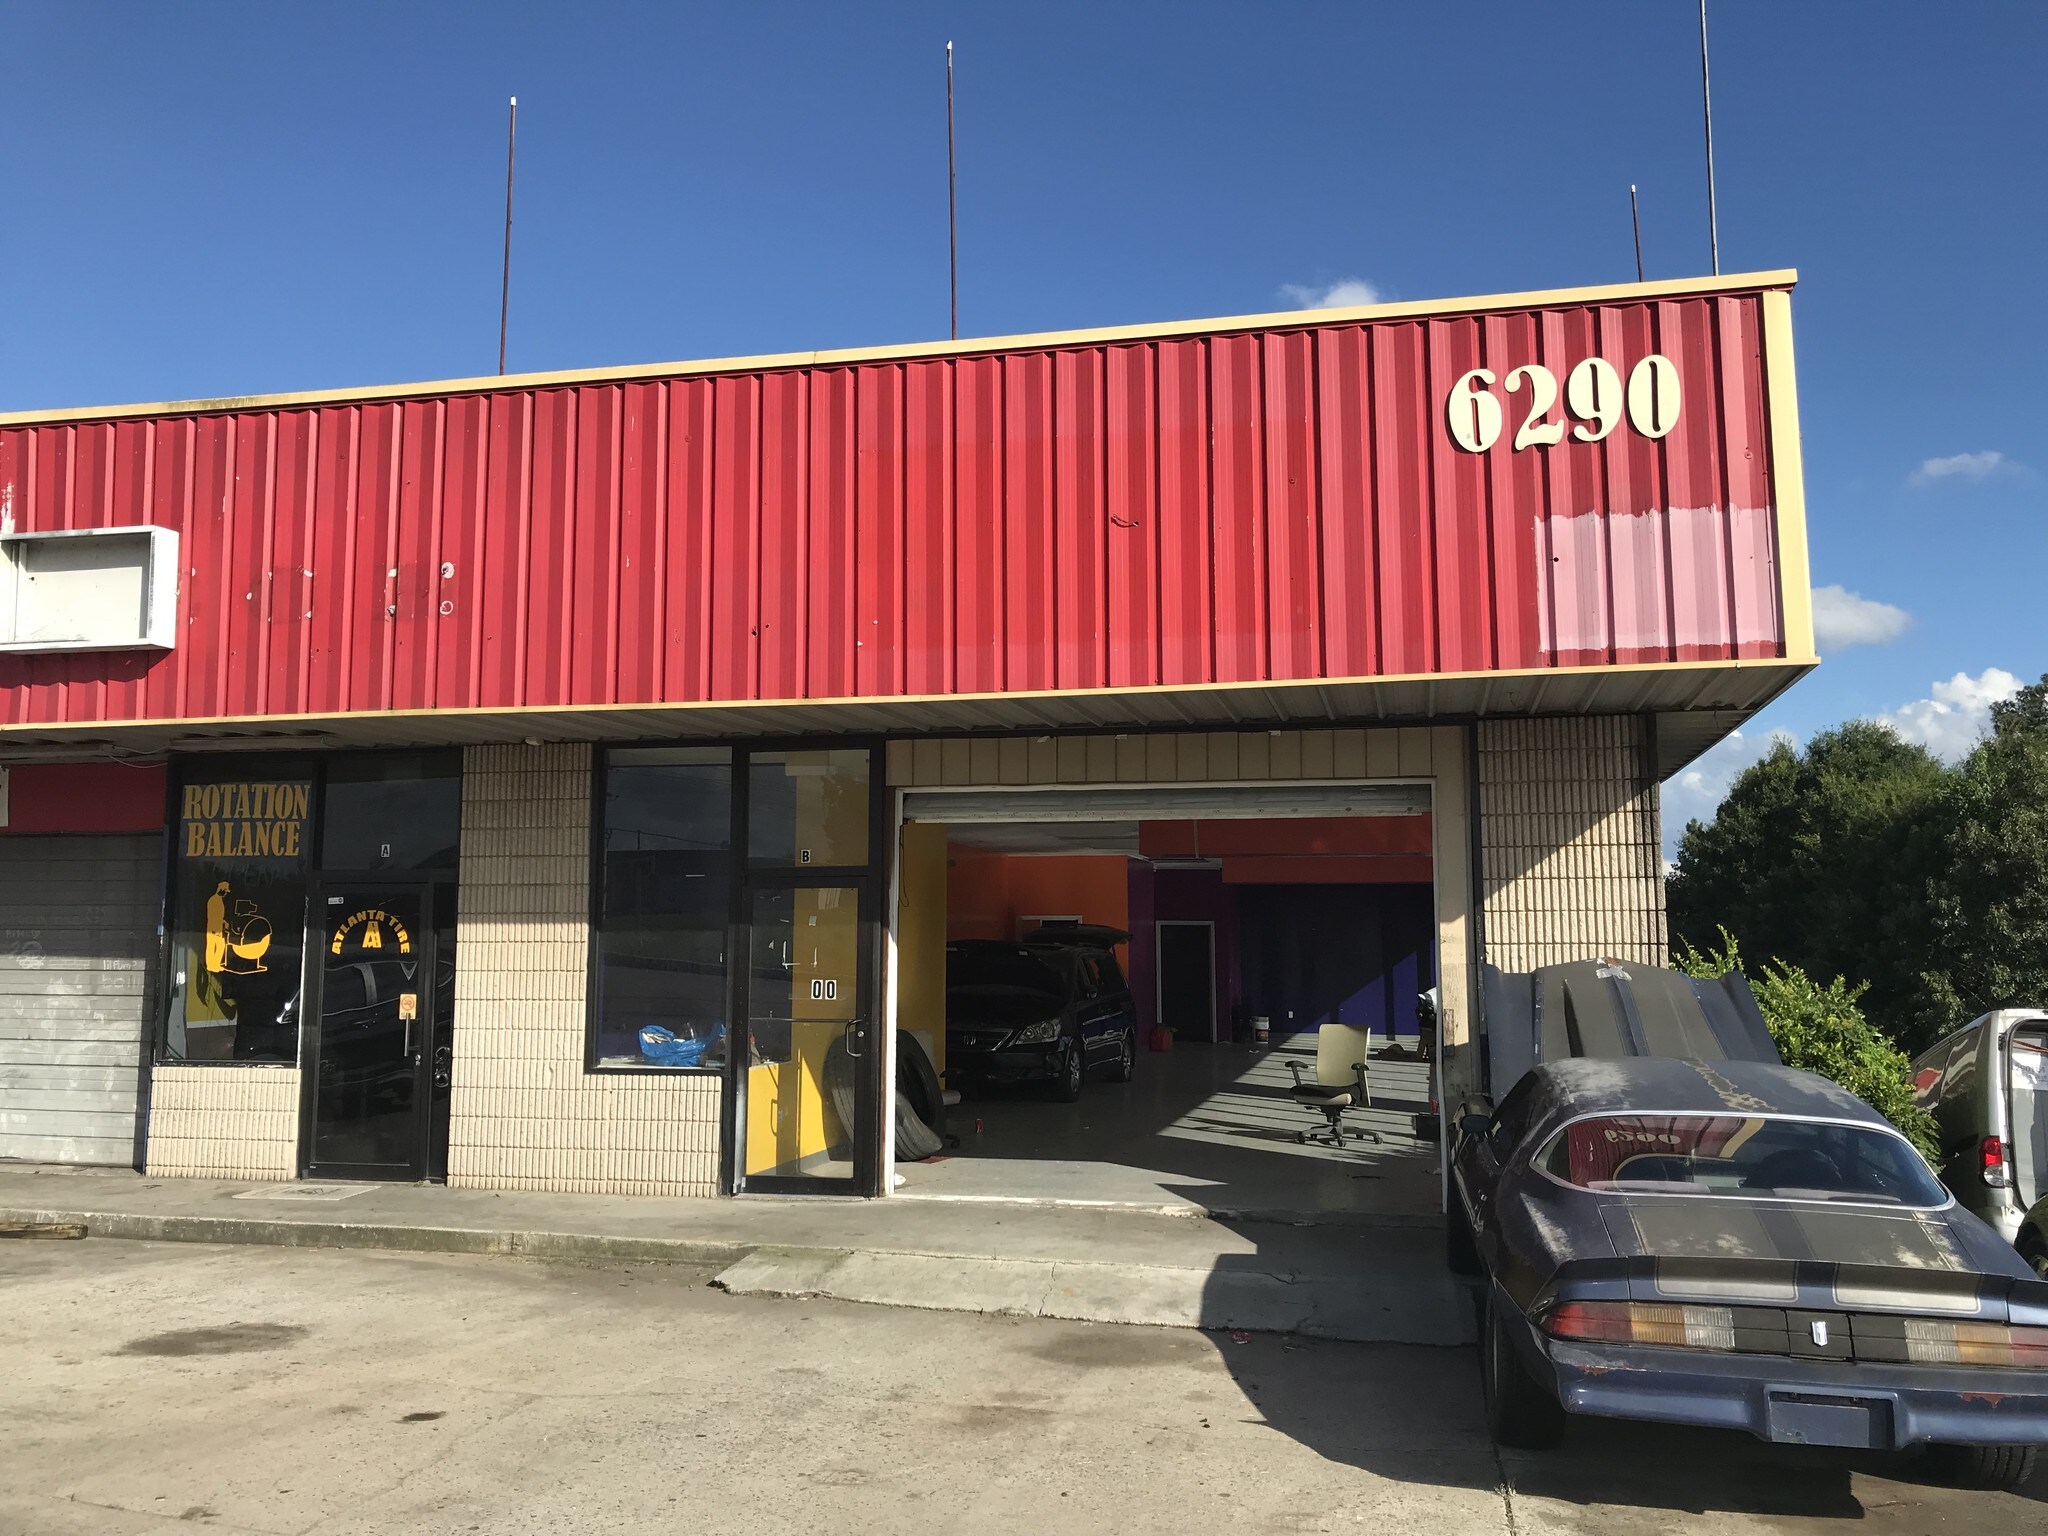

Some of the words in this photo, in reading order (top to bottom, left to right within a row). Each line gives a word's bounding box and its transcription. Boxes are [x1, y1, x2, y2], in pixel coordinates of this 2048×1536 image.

[1448, 354, 1681, 452] 6290
[182, 783, 311, 820] ROTATION
[186, 820, 300, 857] BALANCE
[382, 844, 390, 857] A
[802, 849, 810, 863] B
[331, 909, 385, 955] ATLANTA
[388, 915, 411, 954] TIRE
[812, 980, 836, 999] 00
